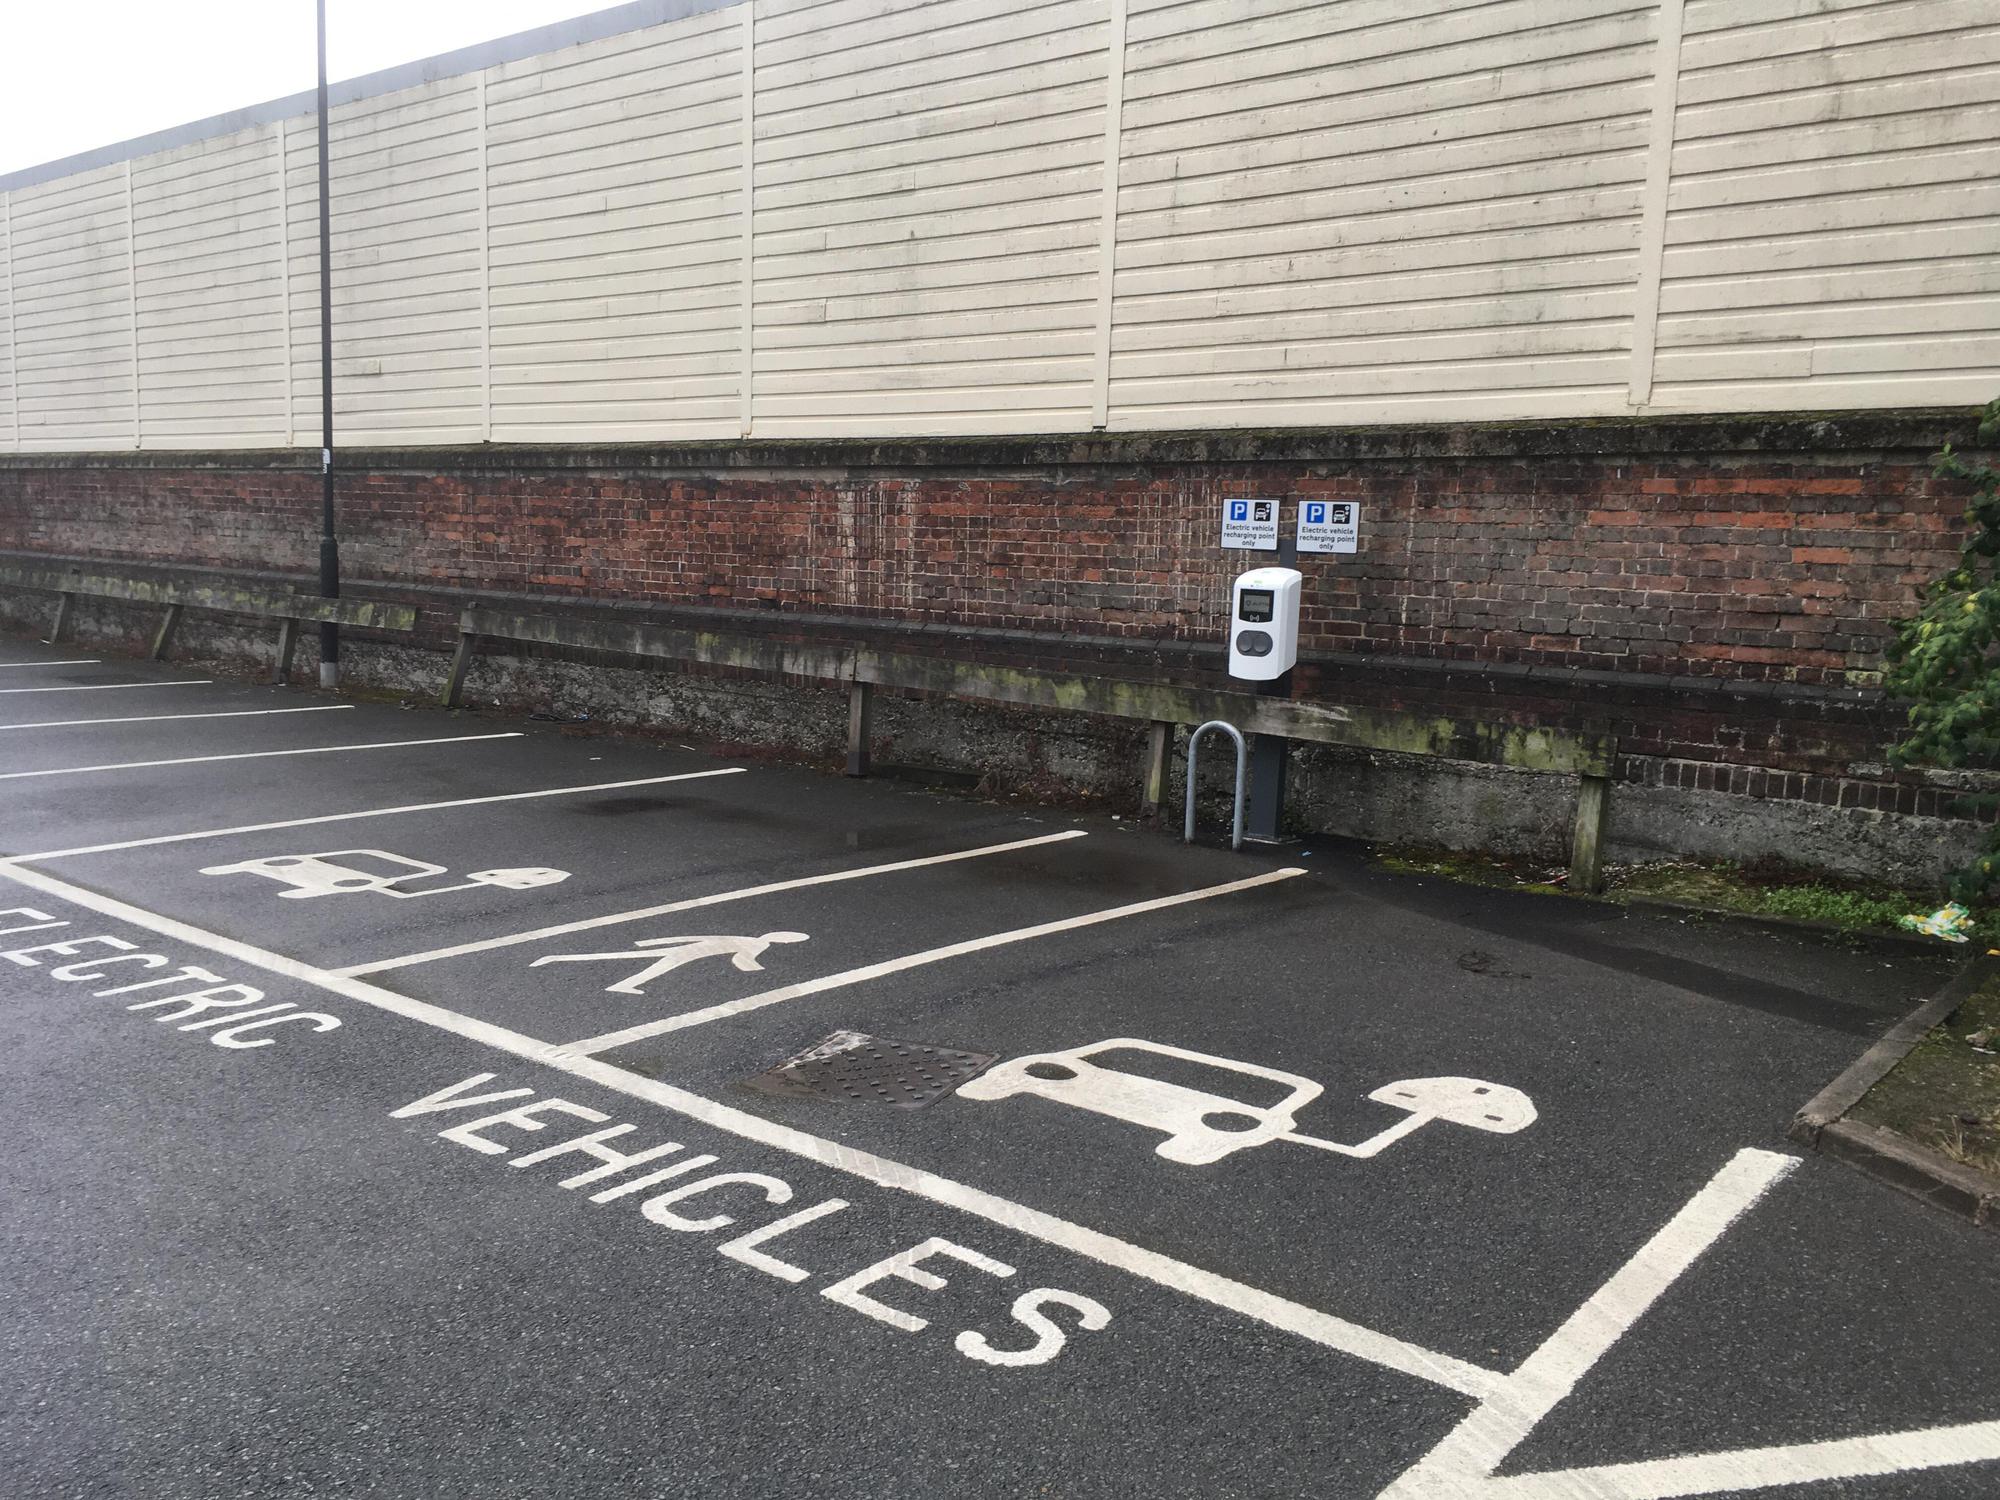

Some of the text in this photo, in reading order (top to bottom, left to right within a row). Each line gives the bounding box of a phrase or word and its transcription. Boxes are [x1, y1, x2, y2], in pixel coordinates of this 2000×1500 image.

[1234, 503, 1246, 519] P
[1310, 505, 1322, 522] P
[1226, 523, 1250, 531] Electric
[1302, 526, 1328, 534] Electric
[1223, 532, 1257, 540] recharging
[1299, 535, 1335, 543] recharging
[1319, 543, 1334, 551] only
[388, 1072, 1113, 1367] VEHICLES
